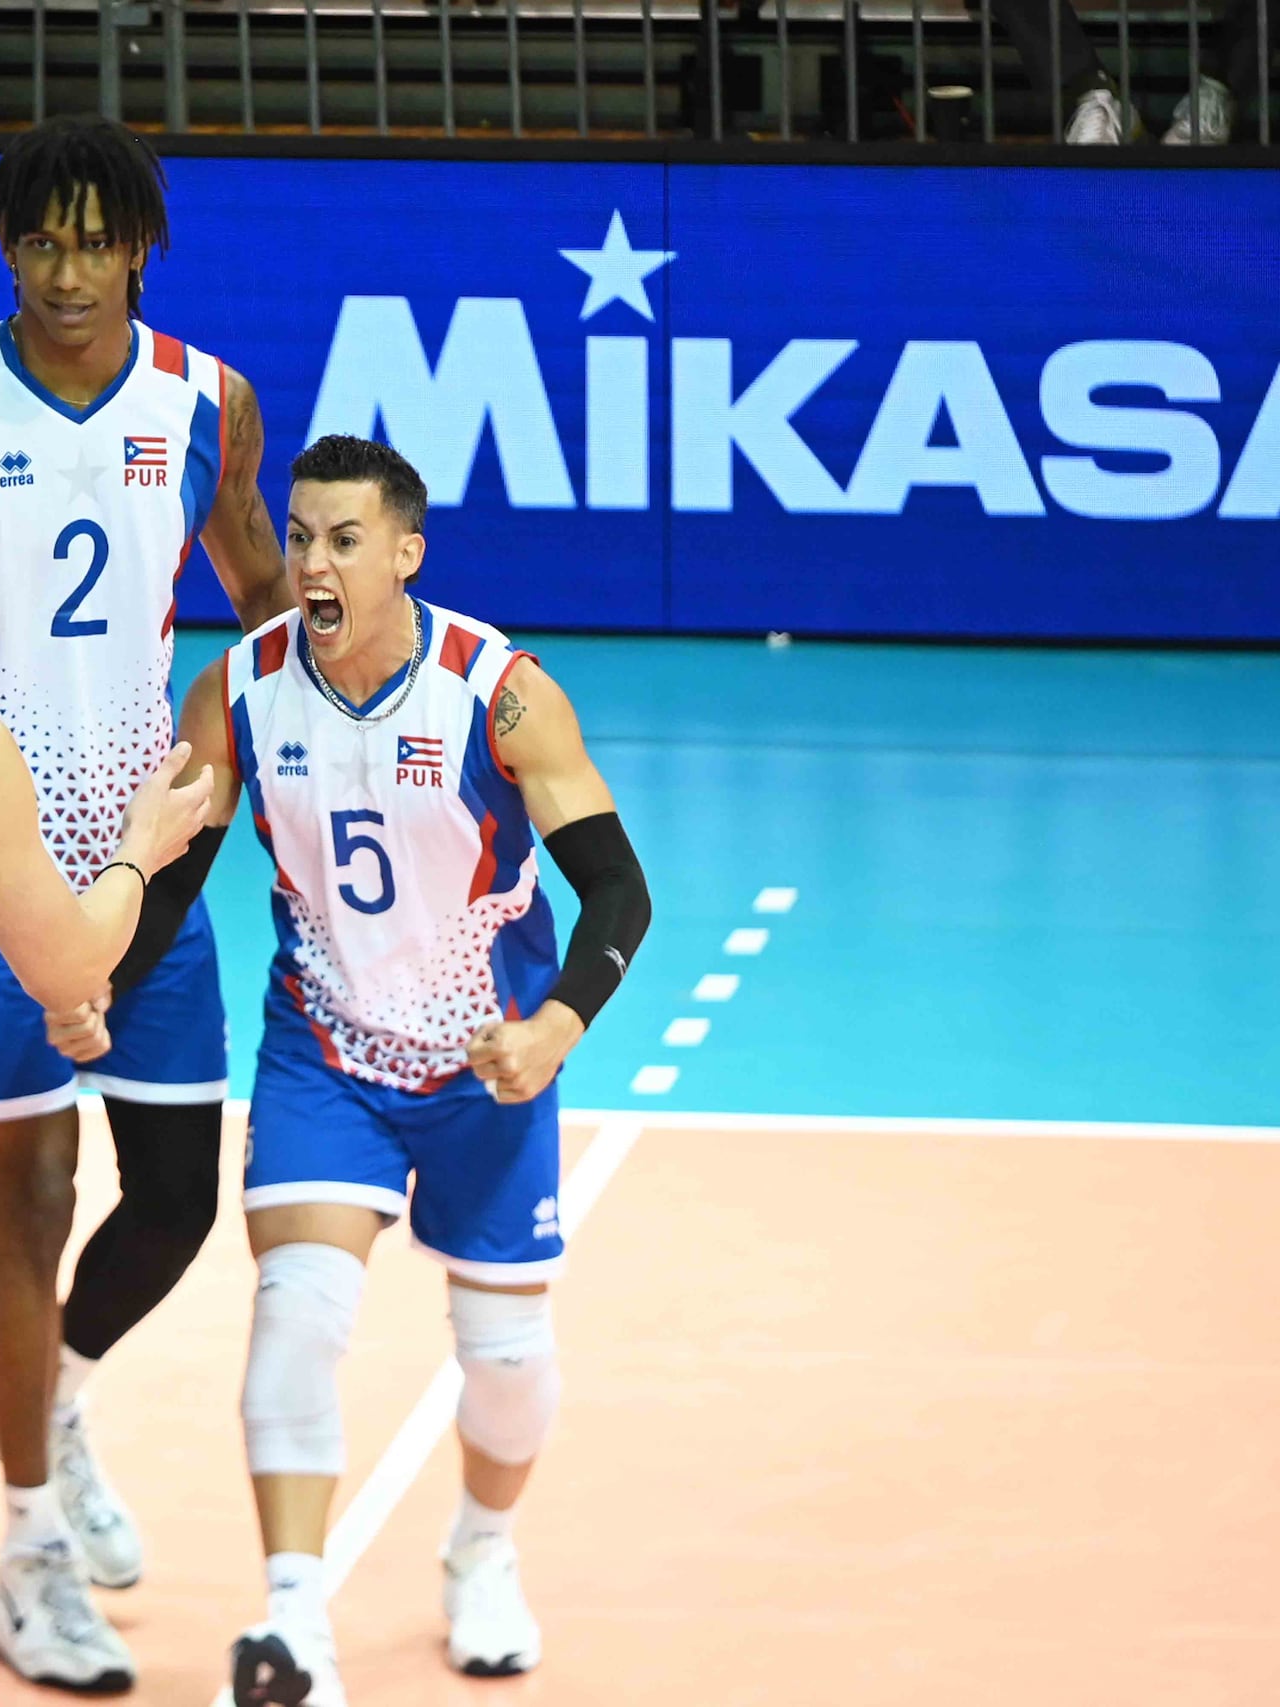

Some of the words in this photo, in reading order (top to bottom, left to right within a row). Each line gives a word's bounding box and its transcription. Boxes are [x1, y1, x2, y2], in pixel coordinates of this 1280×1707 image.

[124, 468, 168, 487] PUR
[50, 518, 109, 637] 2
[396, 767, 443, 788] PUR
[330, 808, 396, 915] 5
